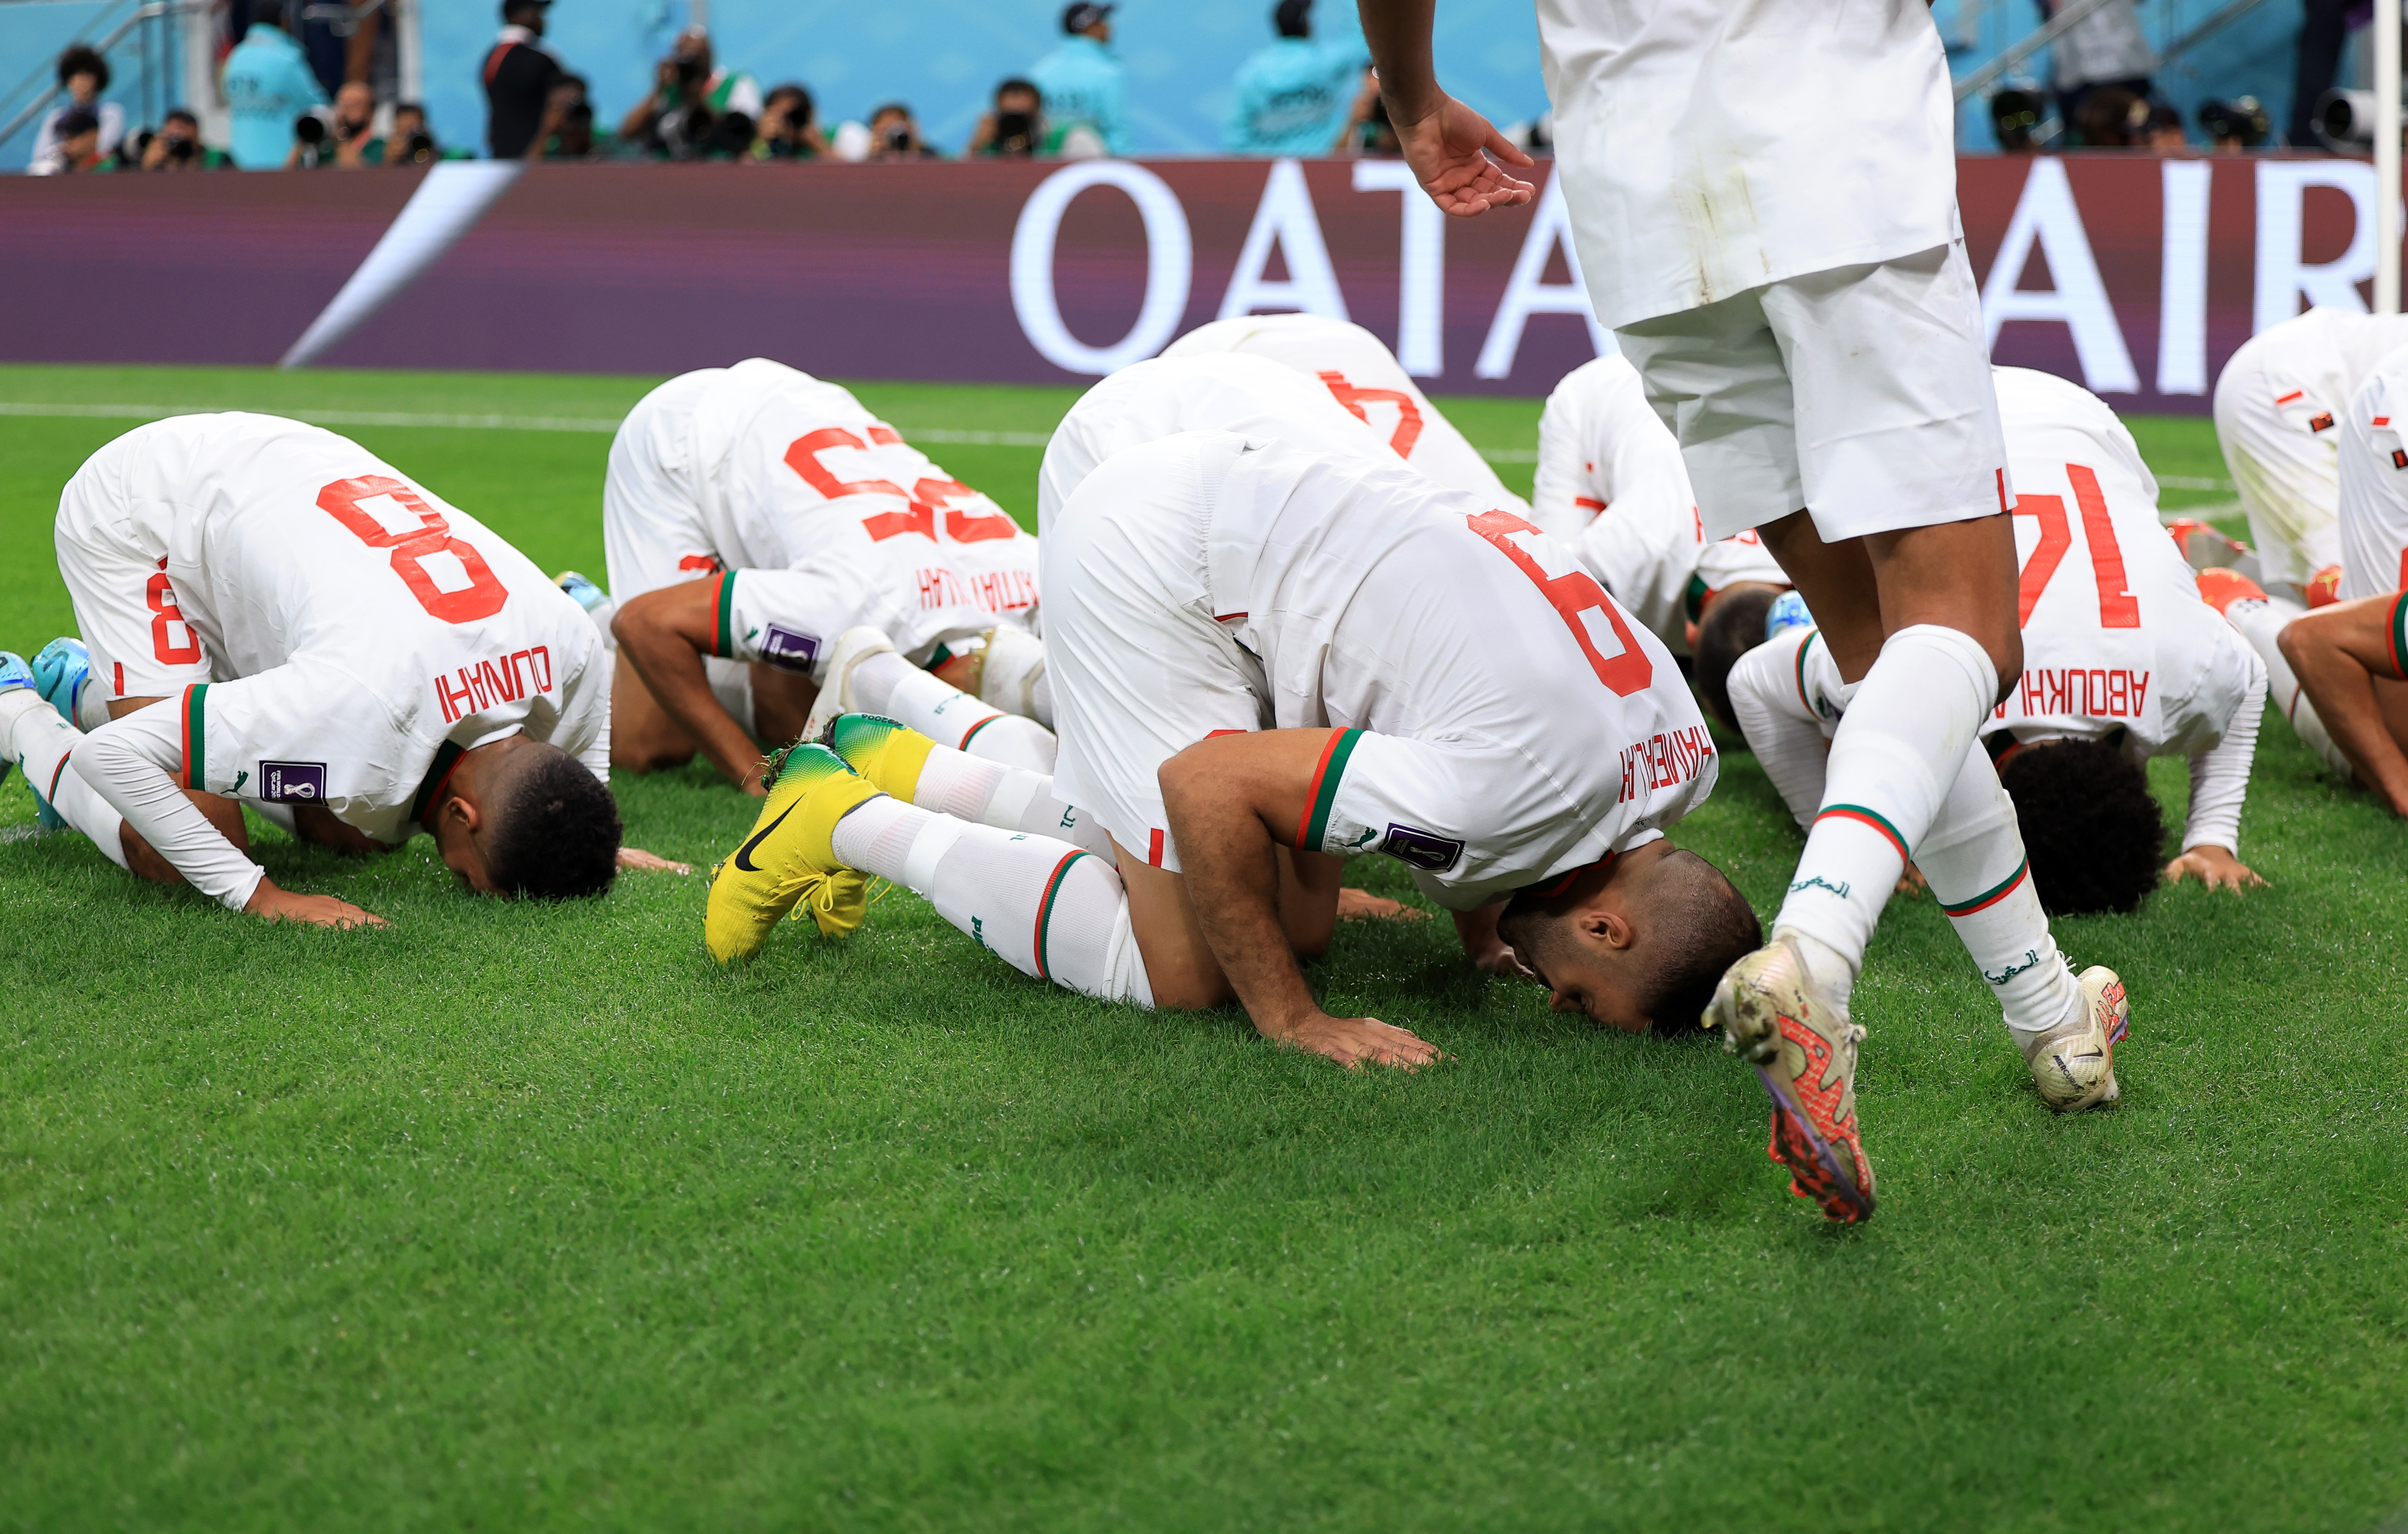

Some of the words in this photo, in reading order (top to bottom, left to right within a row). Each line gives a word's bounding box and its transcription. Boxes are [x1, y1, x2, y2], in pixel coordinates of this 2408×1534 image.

[784, 427, 1017, 544] 25
[315, 474, 508, 624] 8
[1466, 508, 1653, 698] 9
[146, 572, 202, 665] 8
[434, 645, 552, 724] OUNAHI
